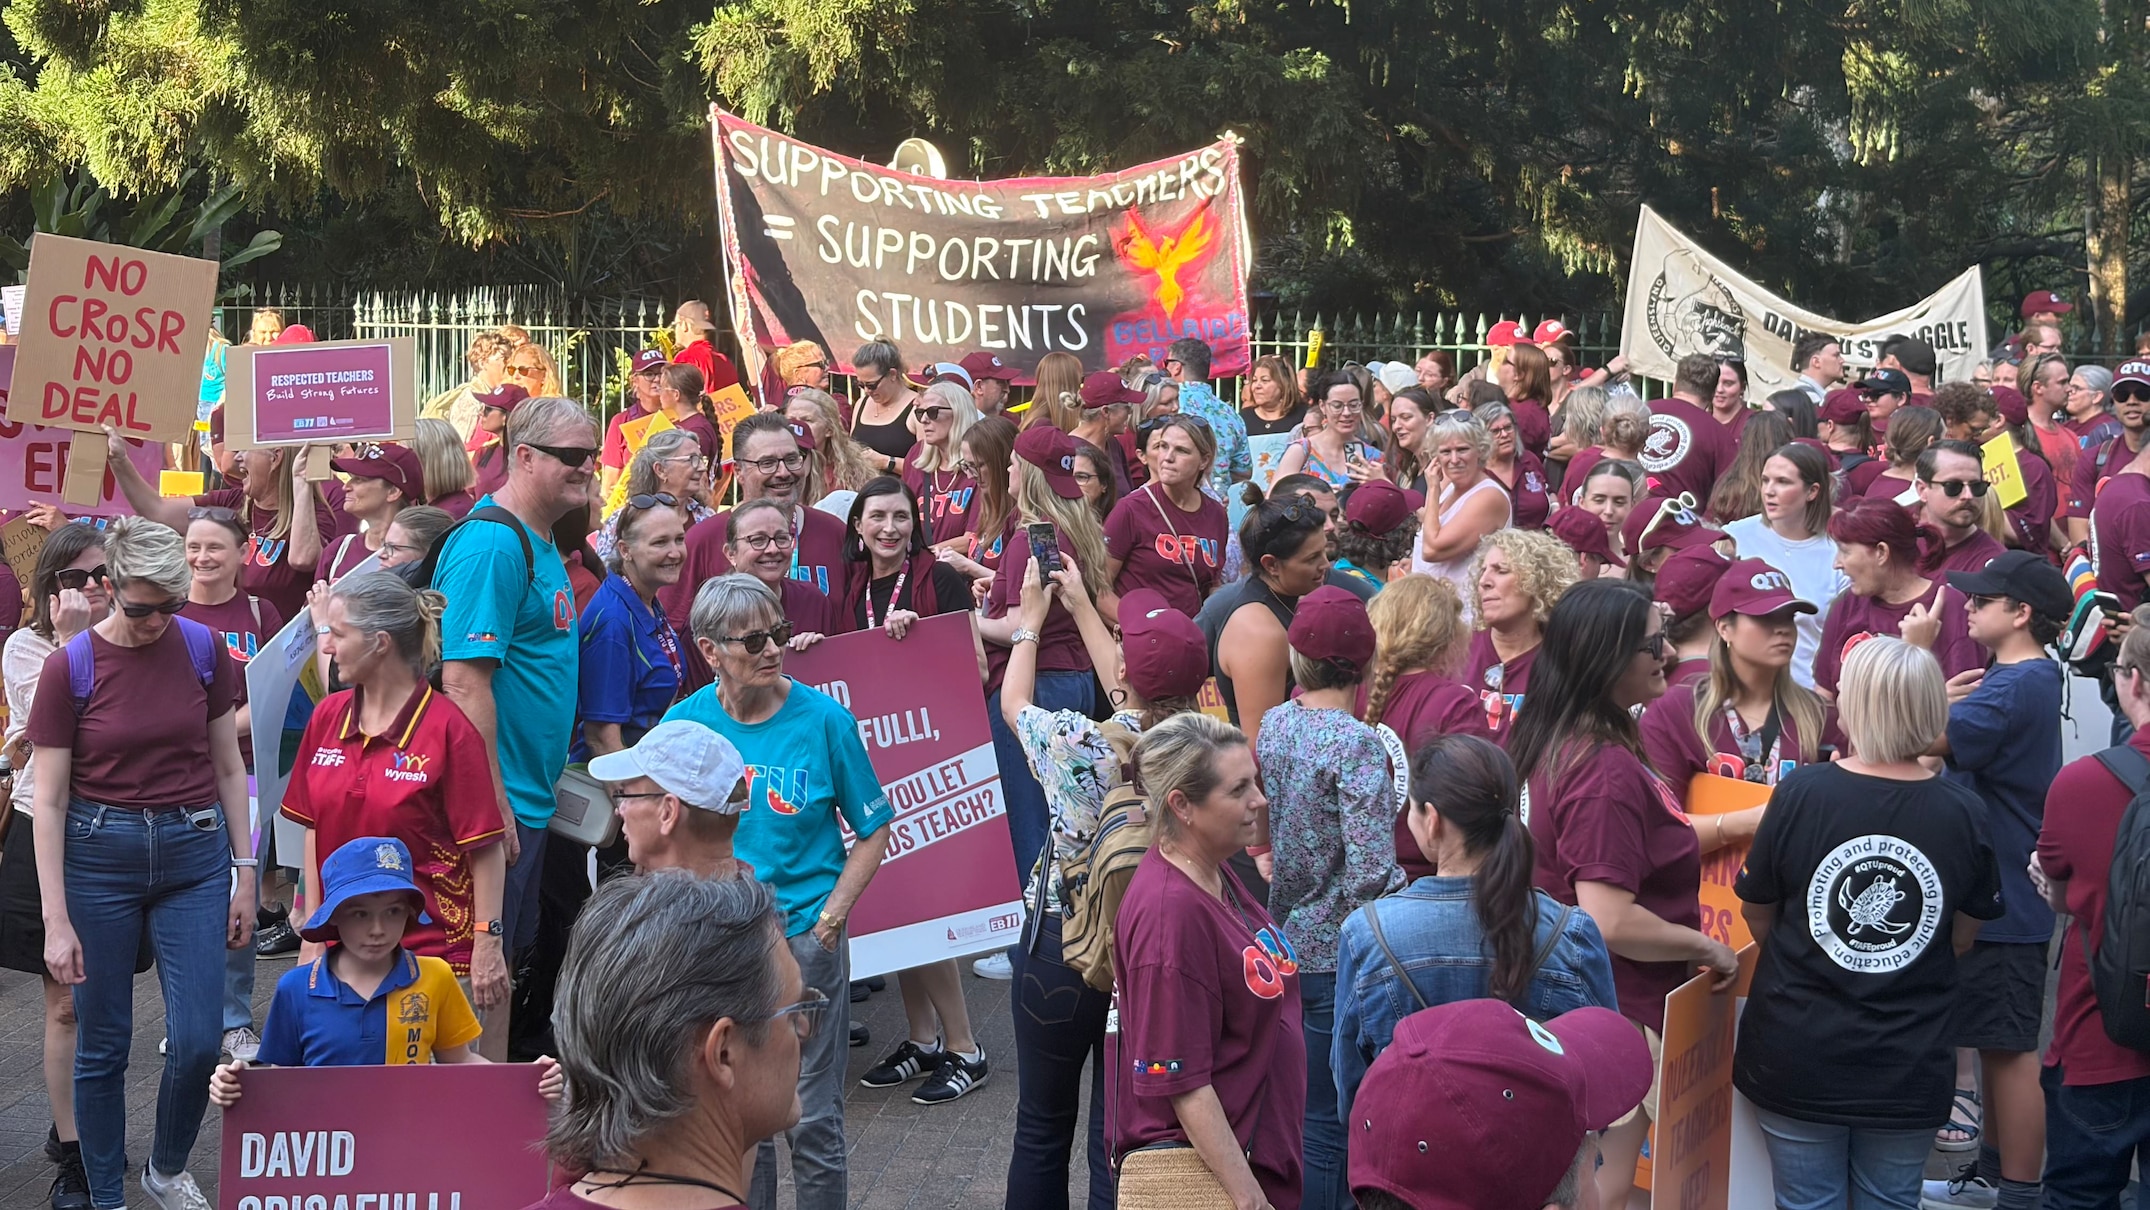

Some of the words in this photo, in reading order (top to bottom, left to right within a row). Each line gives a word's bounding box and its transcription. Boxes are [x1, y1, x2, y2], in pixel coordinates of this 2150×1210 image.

[730, 130, 1004, 219] SUPPORTING
[1020, 149, 1226, 219] TEACHERS
[817, 214, 1100, 282] SUPPORTING
[84, 255, 147, 296] NO
[854, 289, 1089, 351] STUDENTS
[73, 345, 133, 385] NO
[641, 350, 663, 361] QTU
[265, 387, 294, 401] Build
[300, 388, 335, 401] Strong
[340, 386, 379, 397] Futures
[271, 373, 325, 387] RESPECTED
[325, 369, 374, 384] TEACHERS
[42, 383, 151, 432] DEAL
[1155, 532, 1218, 568] QTU
[384, 767, 428, 782] wyresh
[887, 776, 928, 815] YOU
[927, 759, 968, 797] LET
[913, 788, 997, 843] TEACH?
[1843, 837, 1873, 859] and
[1854, 860, 1906, 877] #QTUproud
[1878, 840, 1938, 900] protecting
[989, 914, 1019, 932] EB11
[1911, 904, 1937, 950] public
[1834, 942, 1911, 970] education.
[1848, 938, 1897, 952] #TAFEproud
[240, 1130, 356, 1178] DAVID
